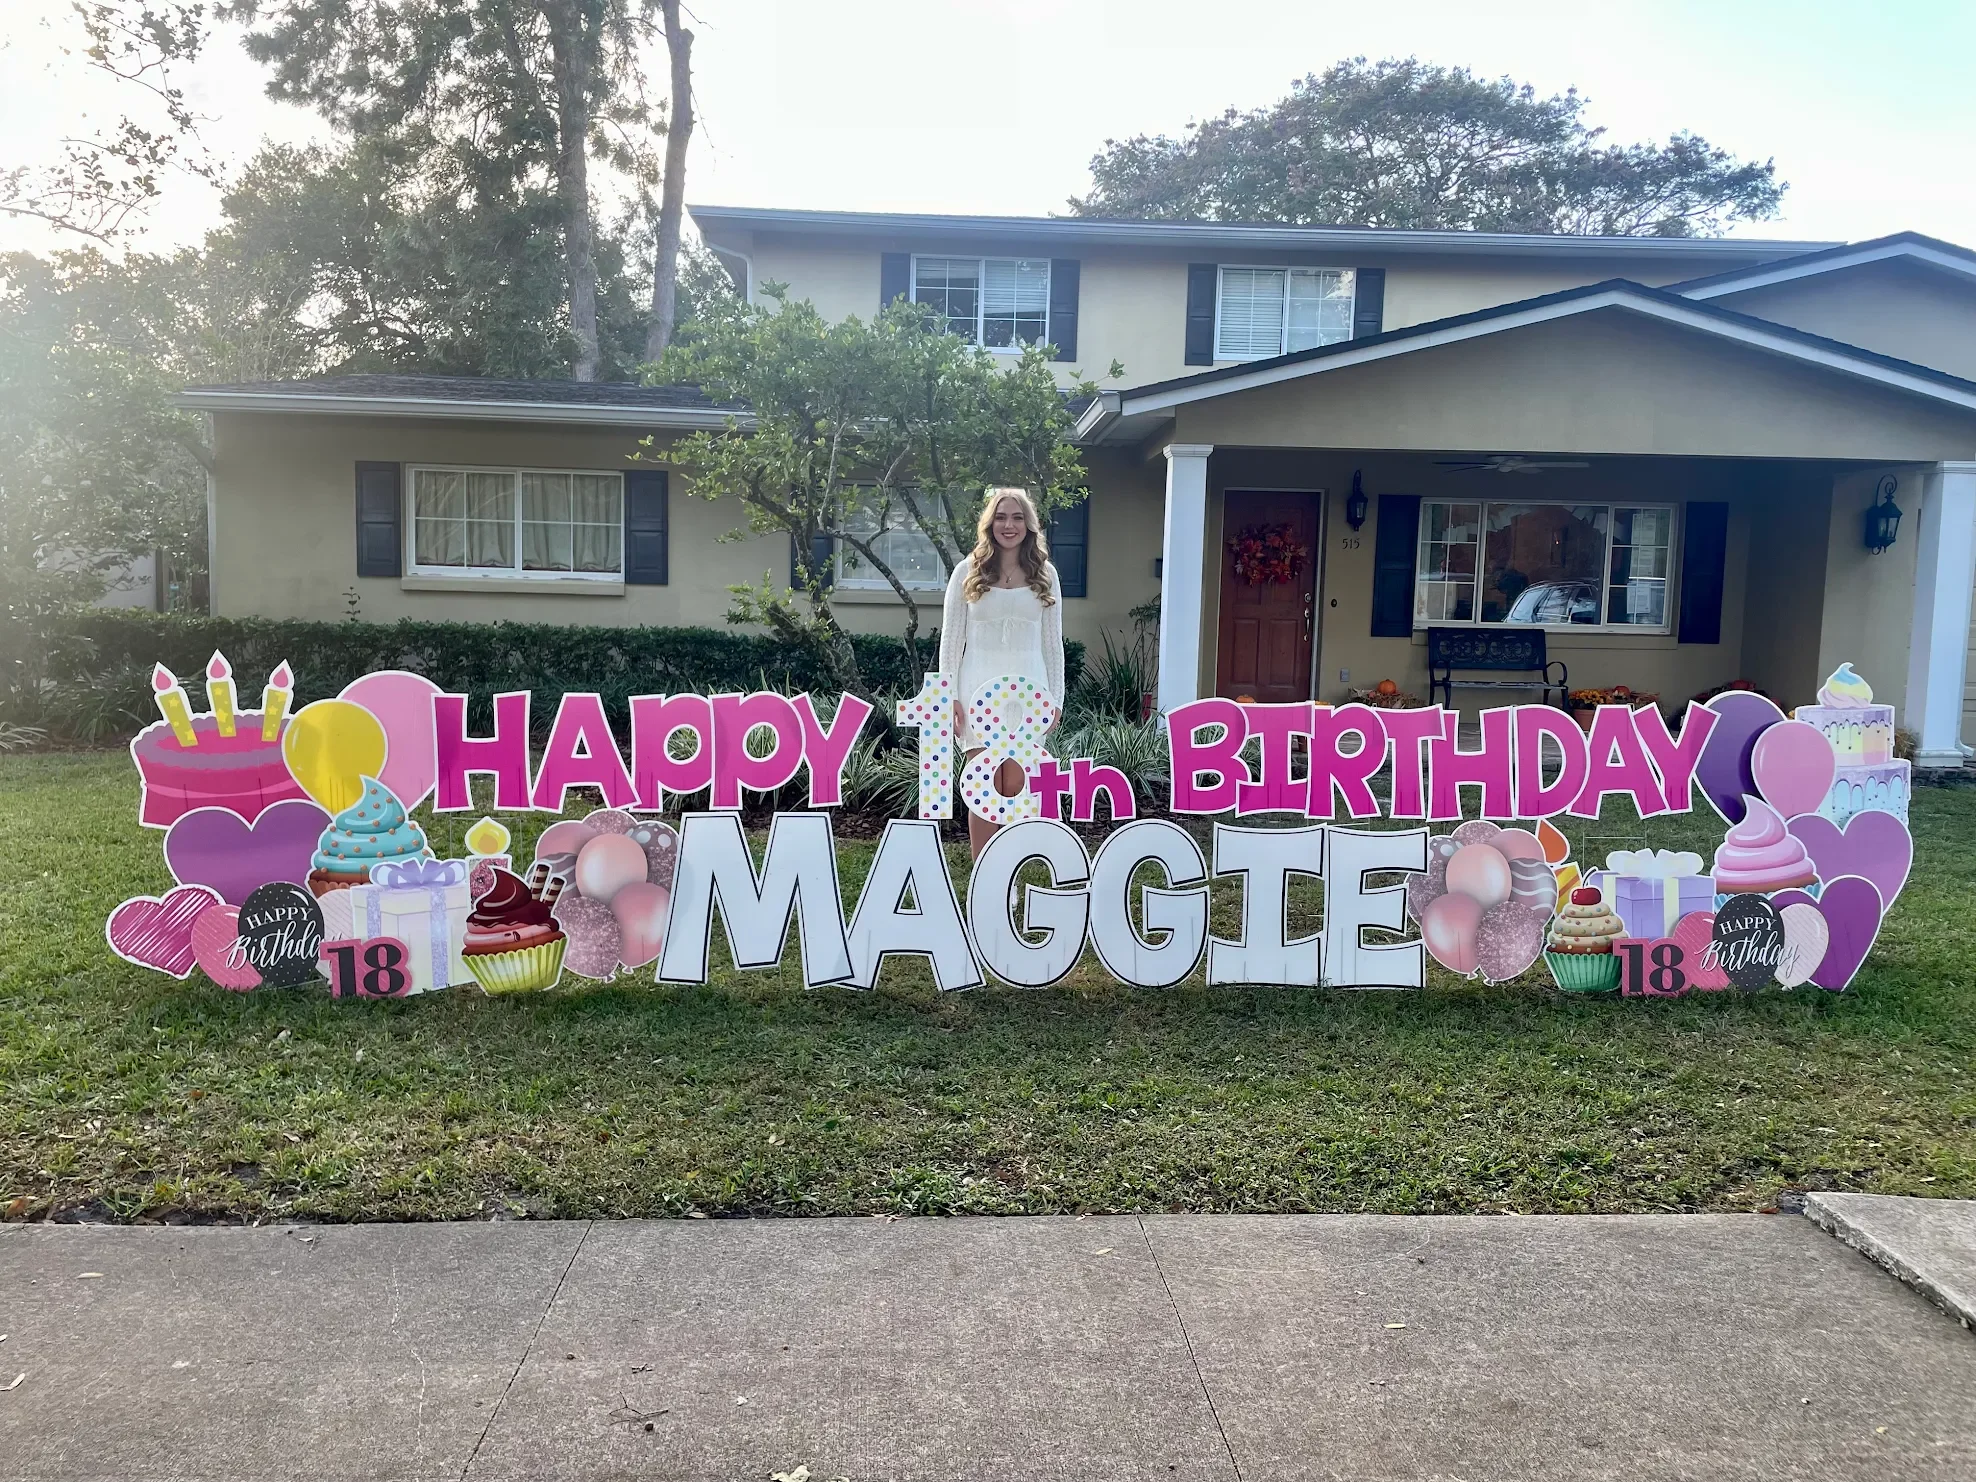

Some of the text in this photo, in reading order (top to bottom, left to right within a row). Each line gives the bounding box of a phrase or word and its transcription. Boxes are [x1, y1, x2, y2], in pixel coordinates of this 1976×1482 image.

[1342, 537, 1360, 550] 515
[432, 690, 874, 813] HAPPY
[1166, 698, 1722, 822] BIRTHDAY
[245, 906, 313, 931] HAPPY
[655, 811, 1430, 992] MAGGIE
[1719, 916, 1777, 937] HAPPY
[217, 919, 342, 971] Birthda
[327, 943, 405, 996] 18
[1620, 943, 1686, 993] 18
[1694, 929, 1801, 979] Birthday
